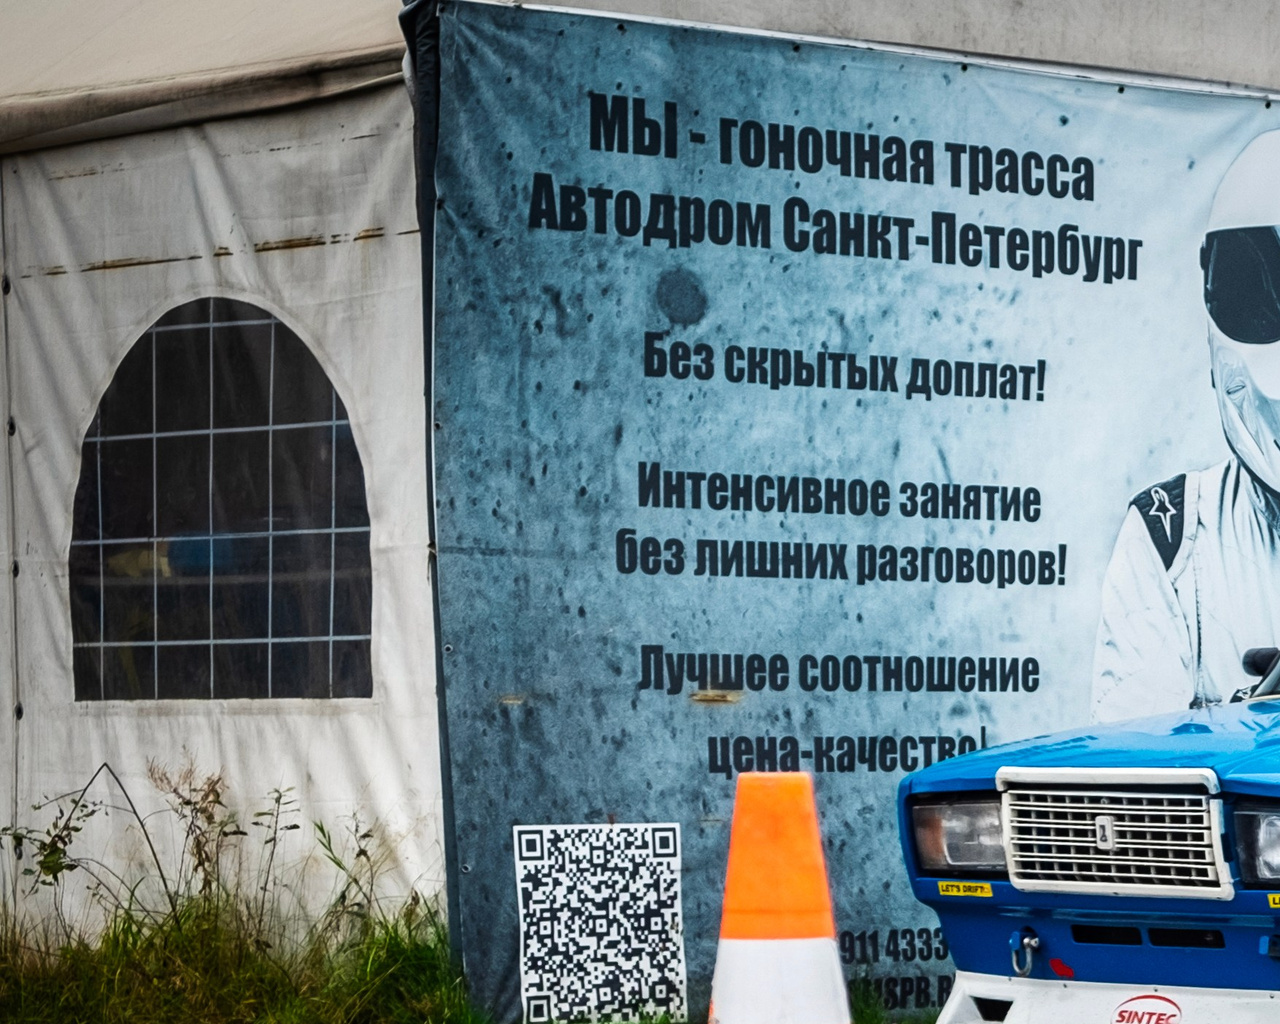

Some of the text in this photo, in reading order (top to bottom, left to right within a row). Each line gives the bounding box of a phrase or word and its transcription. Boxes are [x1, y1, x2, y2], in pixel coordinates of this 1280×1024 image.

[719, 117, 934, 186] гоночная
[944, 141, 1095, 201] трасса
[528, 173, 1143, 284] Автодром Санкт-Петербург
[643, 331, 1047, 401] Без скрытых доплат!
[637, 461, 1041, 522] Интенсивное занятие
[615, 529, 1067, 588] без лишних разговоров!
[638, 645, 1040, 694] Лучшее соотношение
[941, 884, 961, 893] LET'S
